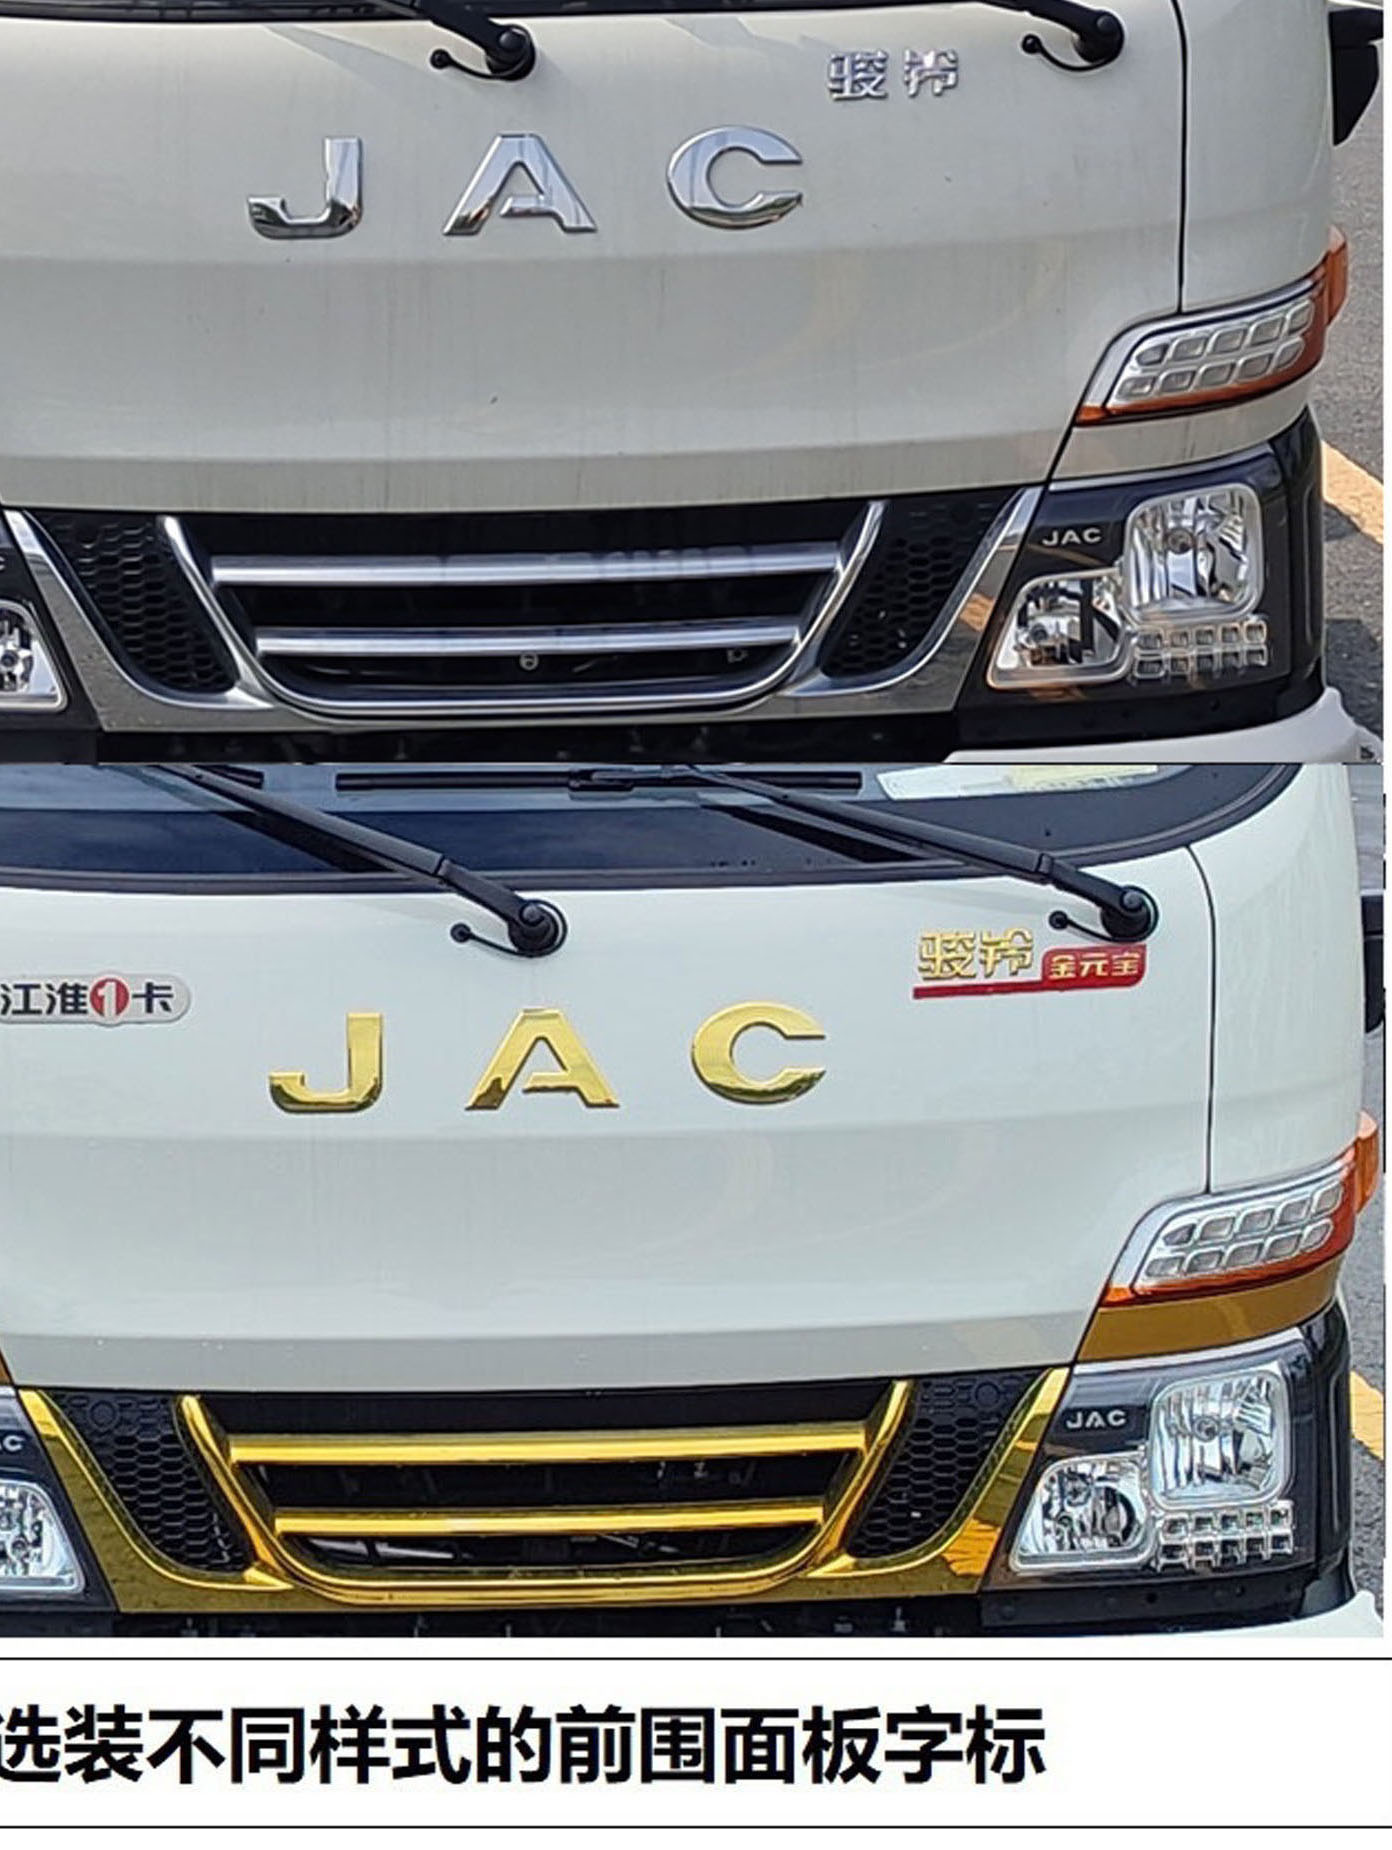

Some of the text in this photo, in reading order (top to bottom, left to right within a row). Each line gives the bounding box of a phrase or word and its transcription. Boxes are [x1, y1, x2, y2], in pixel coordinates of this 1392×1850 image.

[248, 124, 803, 239] JAC
[1042, 527, 1103, 547] JAC
[1049, 951, 1142, 979] 金元宝
[0, 976, 174, 1019] 江淮1卡
[269, 1001, 826, 1113] JAC
[1065, 1408, 1127, 1430] JAC
